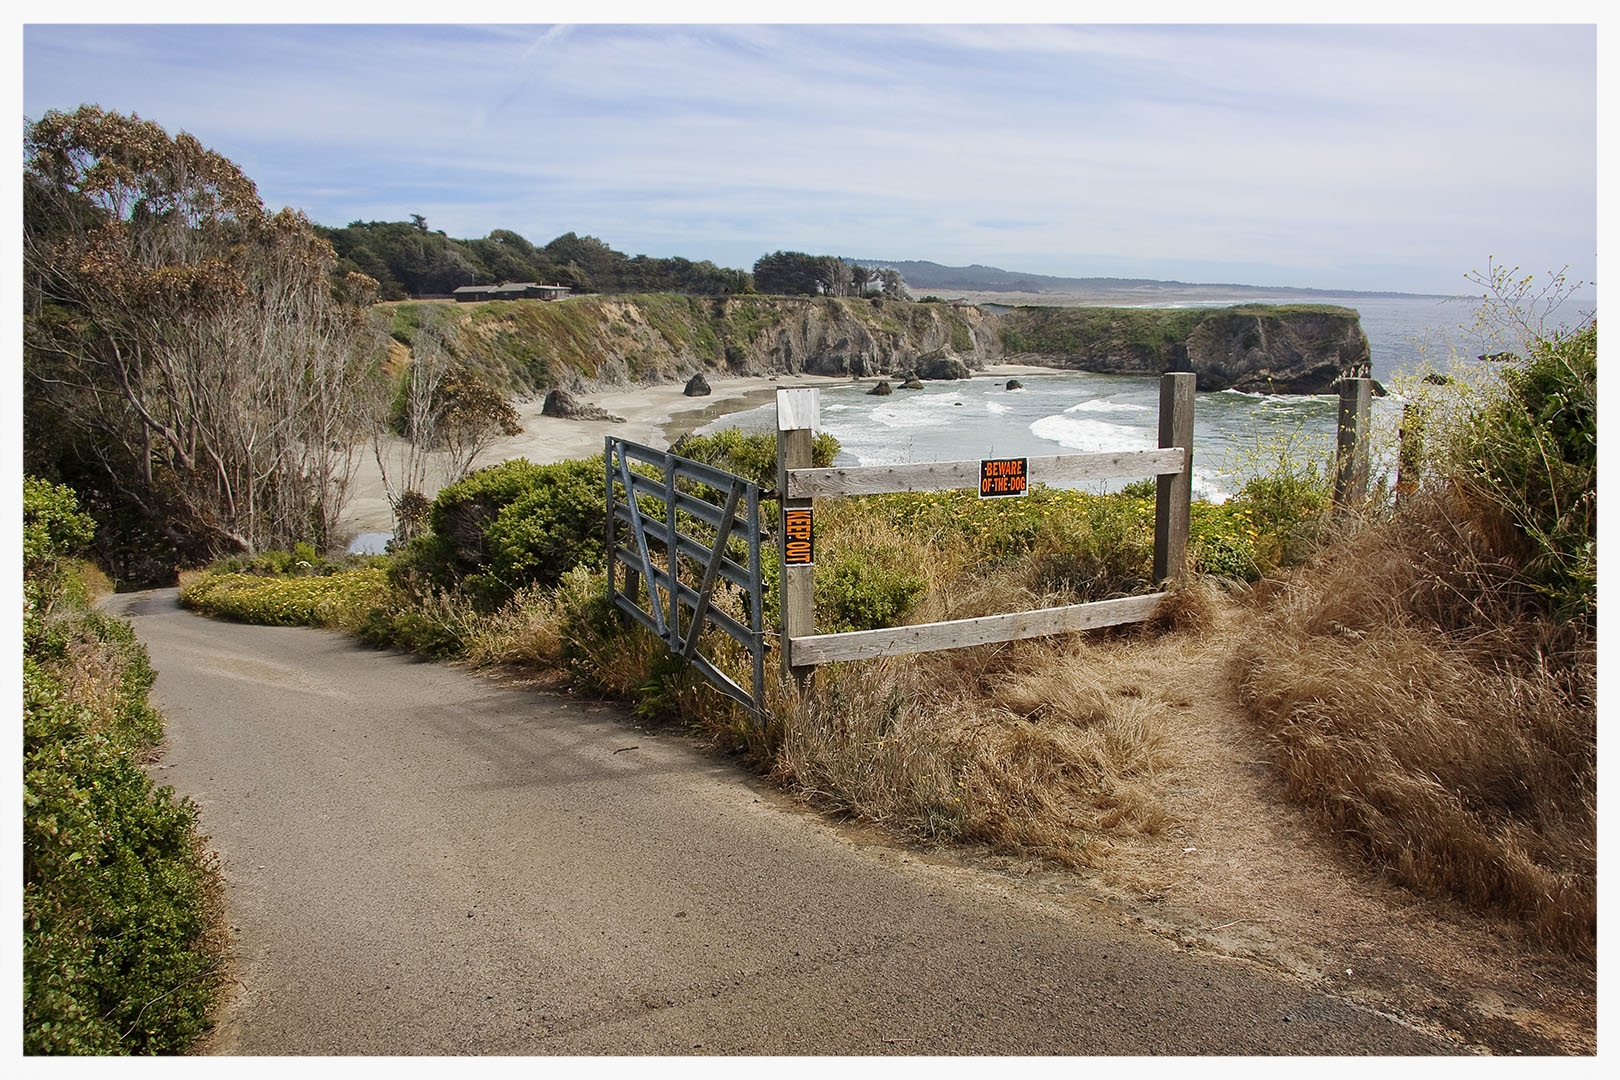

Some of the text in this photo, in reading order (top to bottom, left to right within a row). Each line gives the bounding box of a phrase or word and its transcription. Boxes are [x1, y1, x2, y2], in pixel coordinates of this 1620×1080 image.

[986, 461, 1022, 476] BEWARE
[982, 476, 1025, 492] OF THE DOG
[786, 511, 810, 562] KEEP OUT
